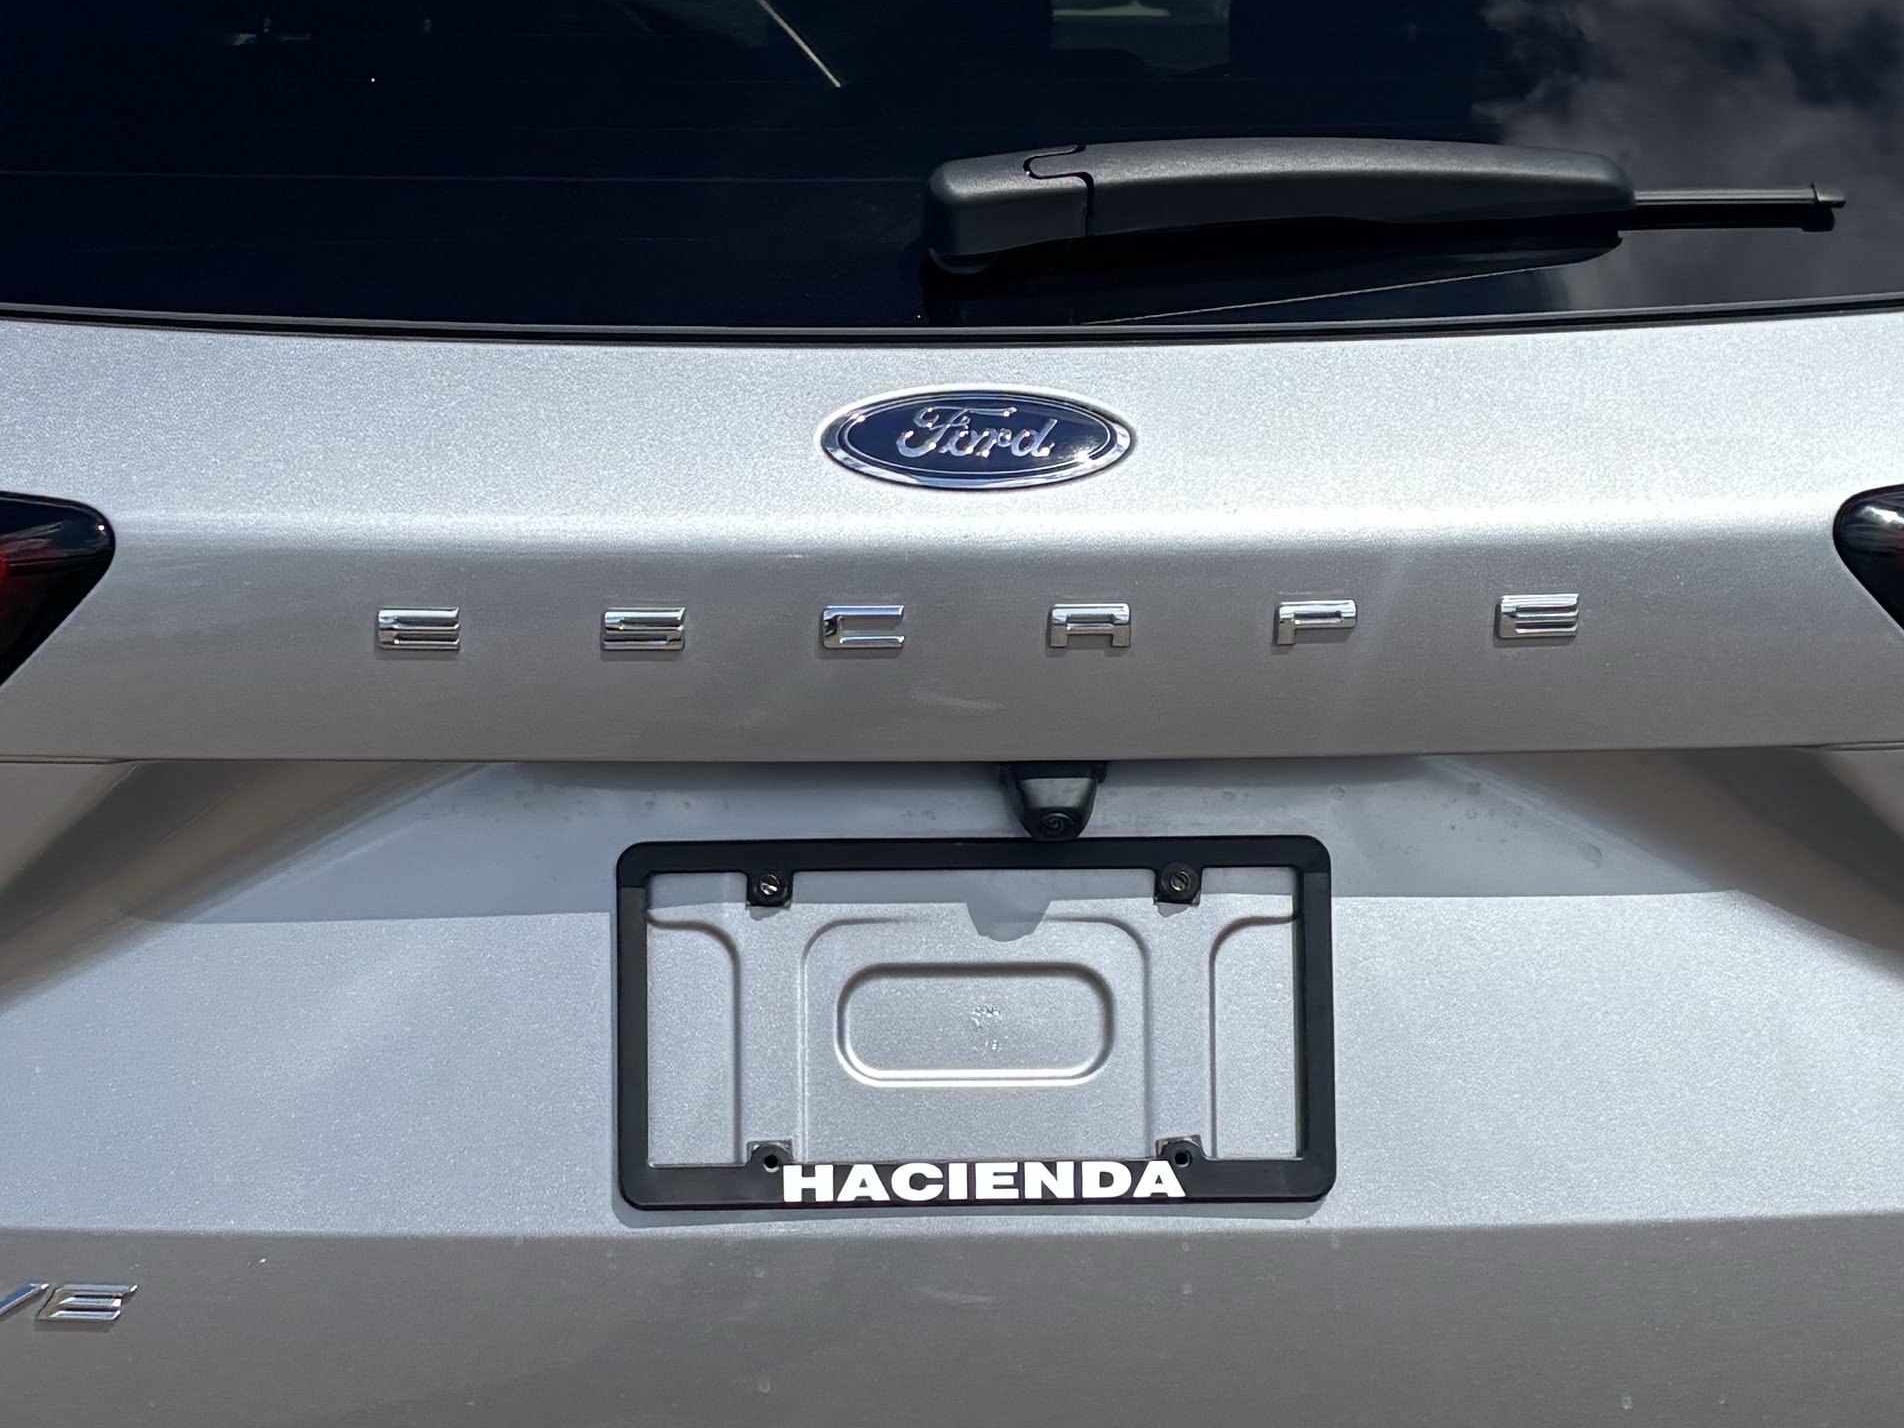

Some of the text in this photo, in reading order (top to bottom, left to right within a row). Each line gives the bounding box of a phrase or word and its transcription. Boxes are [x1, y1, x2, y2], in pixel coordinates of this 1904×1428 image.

[896, 405, 1059, 458] Ford
[377, 592, 1580, 653] ESCAPE
[783, 1160, 1187, 1202] HACIENDA
